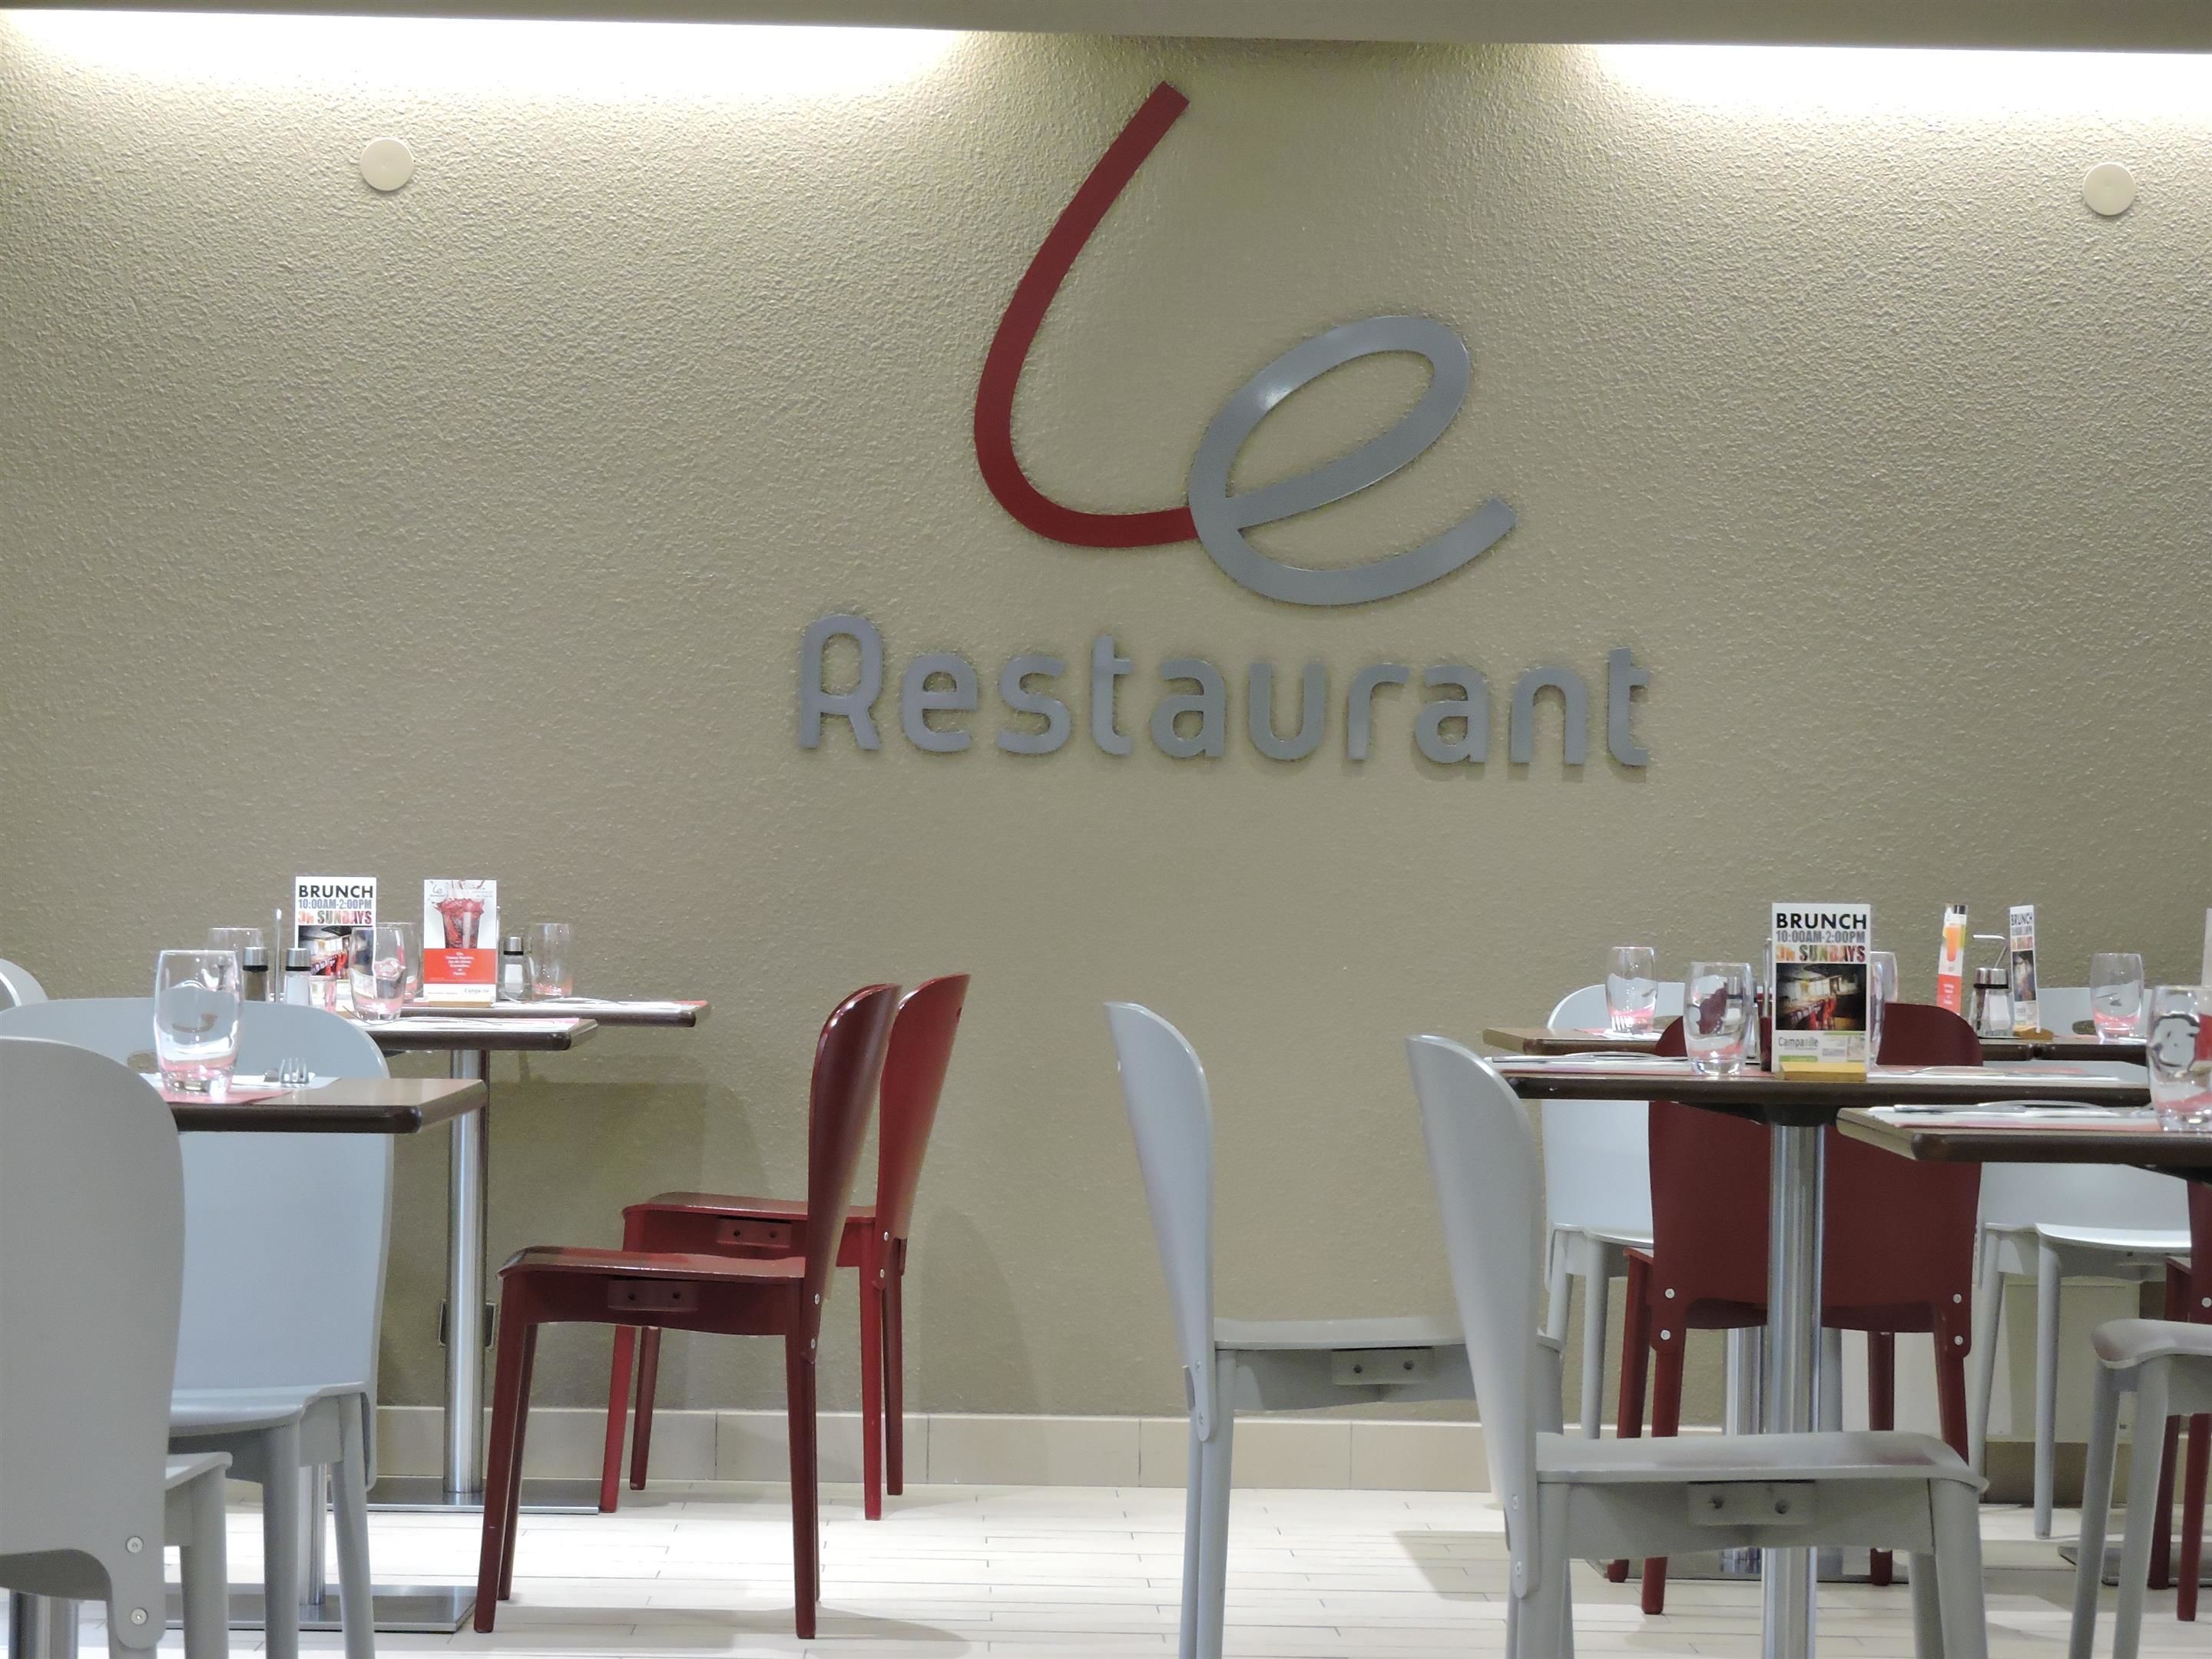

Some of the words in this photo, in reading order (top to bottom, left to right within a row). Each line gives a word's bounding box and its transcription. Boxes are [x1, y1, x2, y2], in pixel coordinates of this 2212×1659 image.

[798, 614, 1651, 768] Restaurant
[299, 885, 373, 898] BRUNCH
[298, 899, 373, 909] 10:00AM-2:00PM
[317, 910, 373, 925] SUNDAYS
[1776, 912, 1867, 929] BRUNCH
[1776, 930, 1866, 943] 10:00AM-2:00PM
[1799, 945, 1866, 962] SUNDAYS
